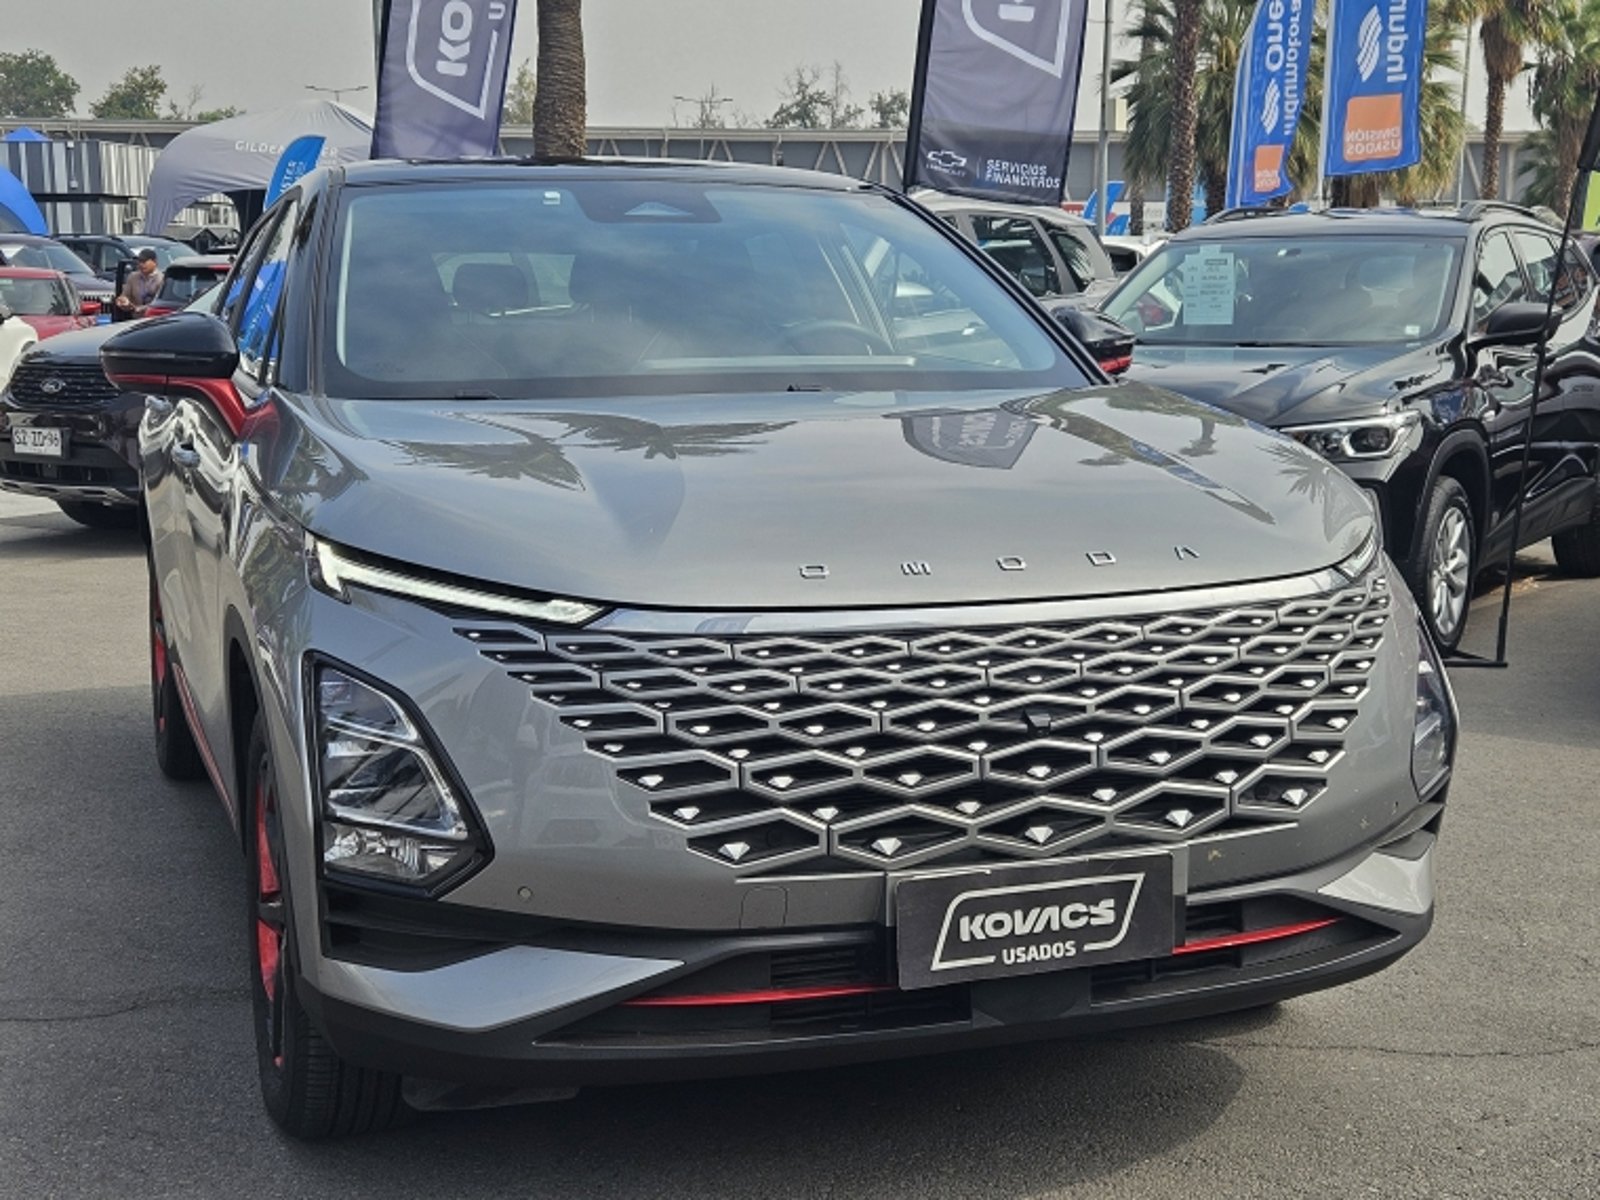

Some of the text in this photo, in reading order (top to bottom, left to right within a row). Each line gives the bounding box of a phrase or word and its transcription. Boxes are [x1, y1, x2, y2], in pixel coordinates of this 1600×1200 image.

[986, 159, 1047, 175] SERVICIOS
[985, 172, 1061, 189] FINANCIEROS
[959, 898, 1116, 942] KOVACS
[1002, 941, 1077, 965] USADOS
